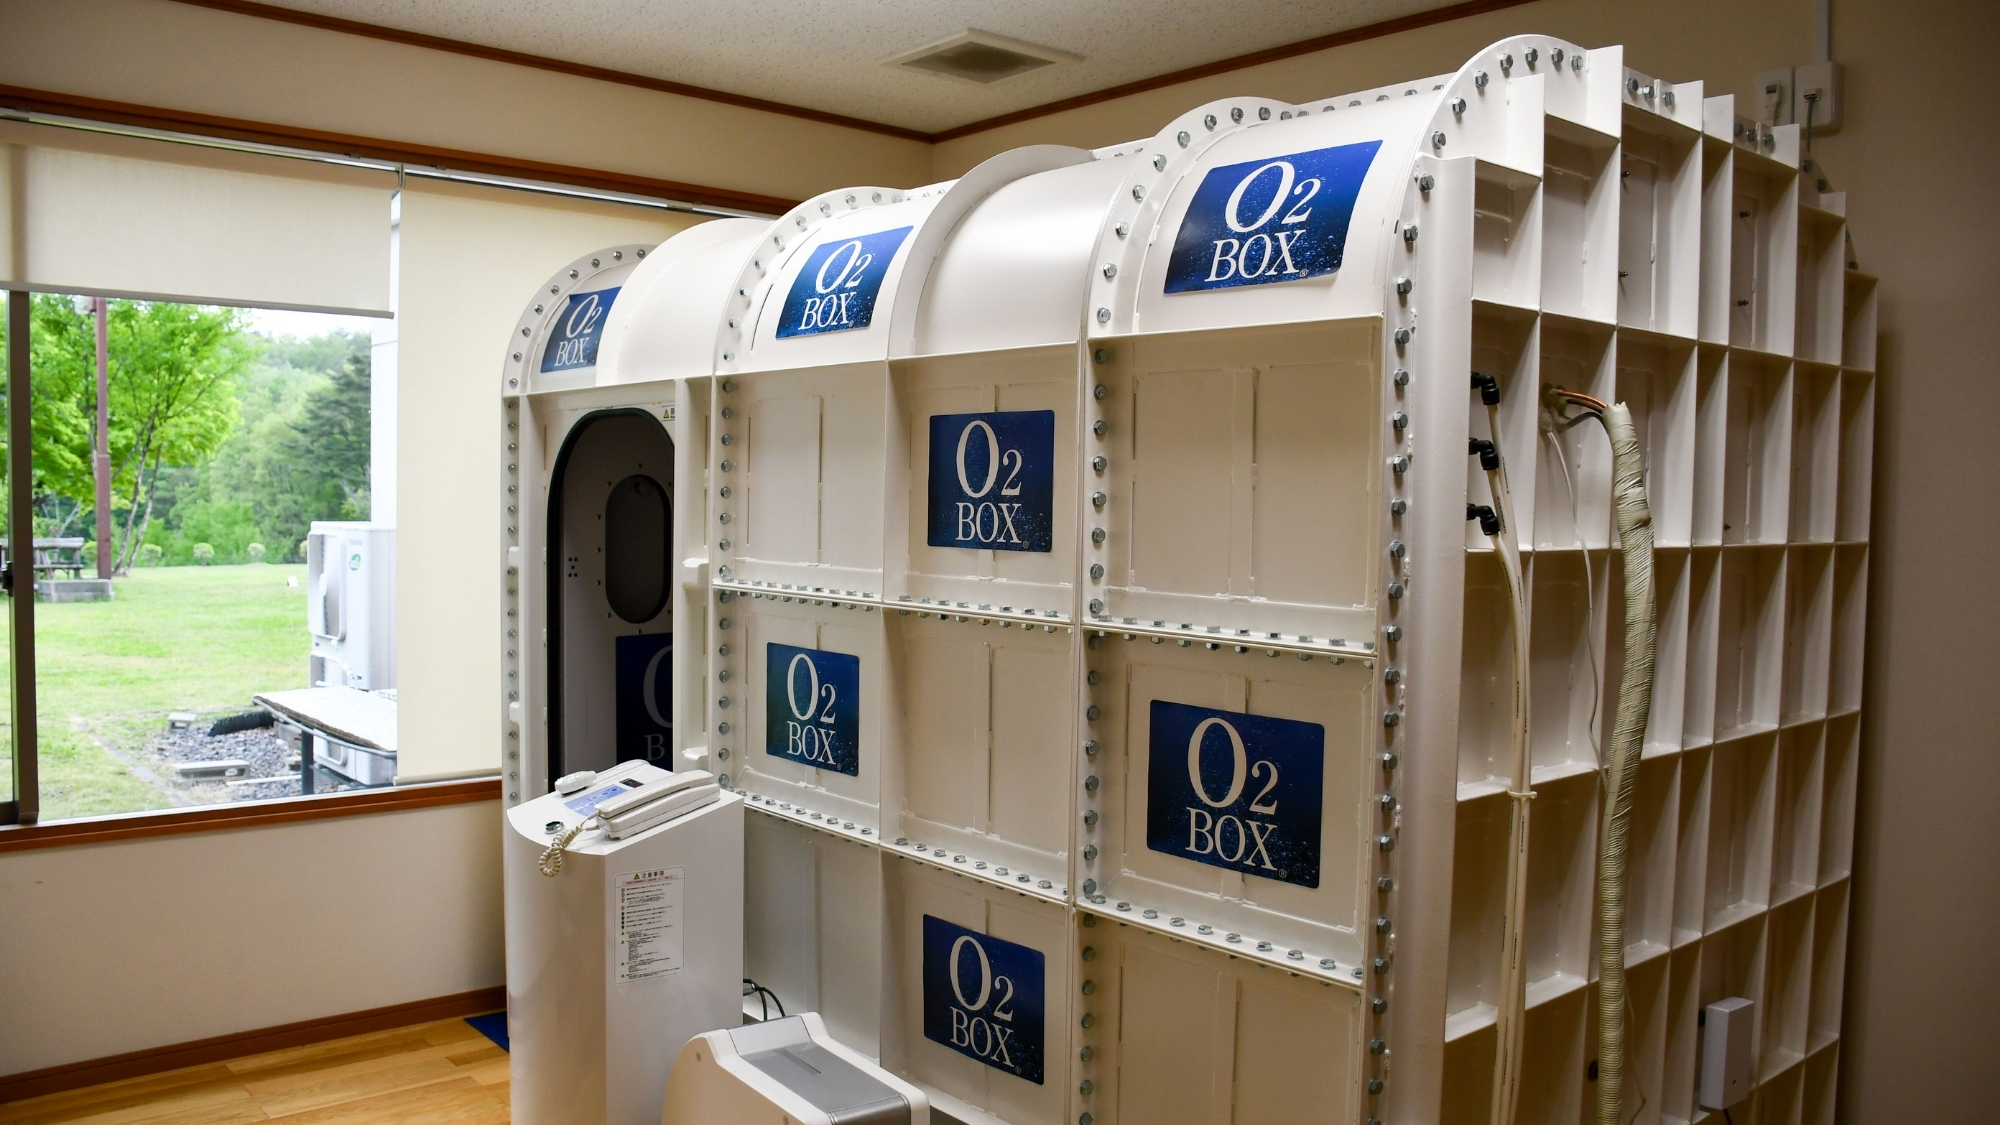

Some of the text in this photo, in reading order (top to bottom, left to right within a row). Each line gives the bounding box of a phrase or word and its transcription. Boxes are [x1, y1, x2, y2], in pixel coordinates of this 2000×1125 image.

[1225, 161, 1321, 233] O2
[815, 240, 872, 294] O2
[1204, 229, 1306, 282] BOX
[566, 294, 602, 338] O2
[797, 291, 857, 330] BOX
[554, 337, 590, 367] BOX
[956, 420, 1022, 498] O2
[955, 502, 1022, 544] BOX
[787, 653, 836, 724] O2
[786, 720, 836, 765] BOX
[1187, 717, 1279, 816] O2
[1185, 806, 1278, 871] BOX
[950, 935, 1014, 1022] O2
[950, 1005, 1014, 1067] BOX
